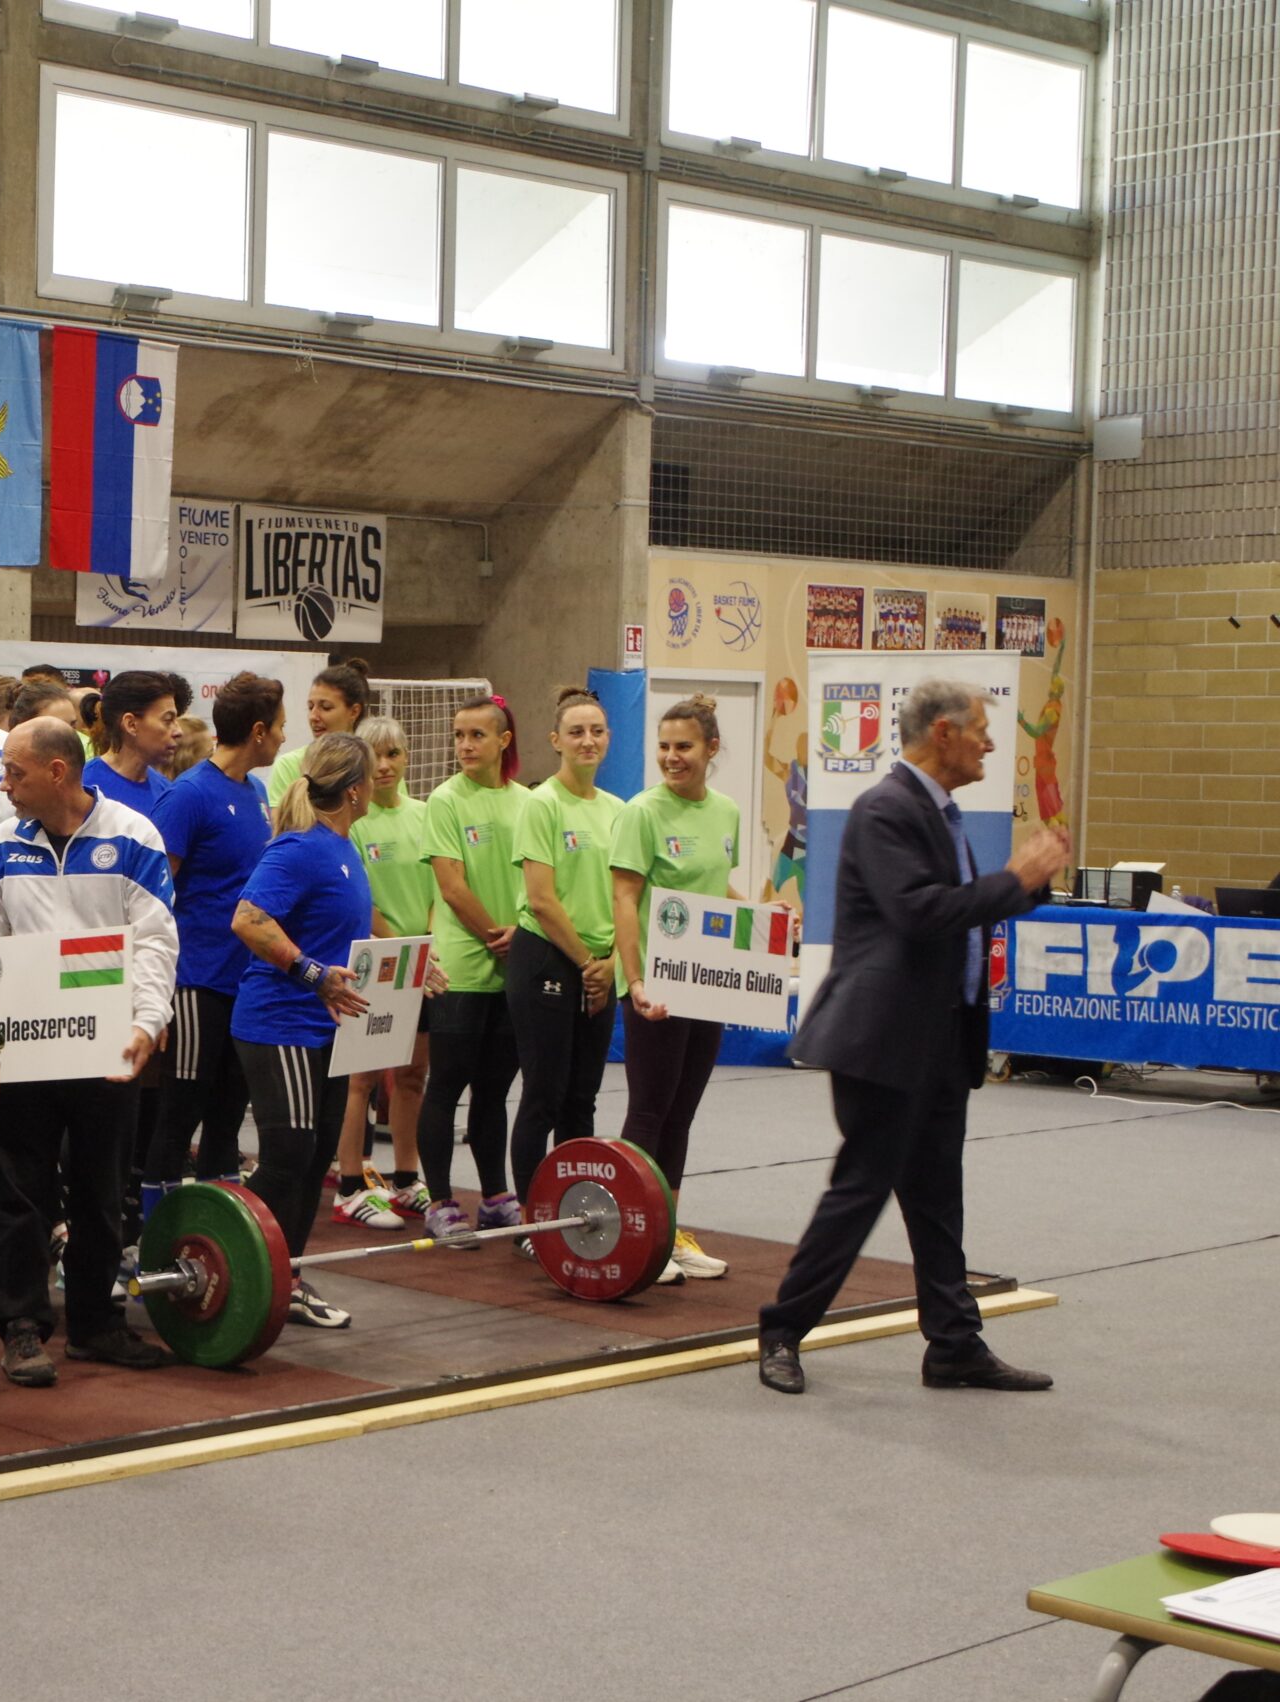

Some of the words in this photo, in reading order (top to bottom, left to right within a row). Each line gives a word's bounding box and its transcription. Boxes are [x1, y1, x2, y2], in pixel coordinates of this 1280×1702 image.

[179, 507, 230, 528] FIUME
[179, 531, 229, 546] VENETO
[245, 519, 381, 604] LIBERTAS
[826, 686, 878, 698] ITALIA
[827, 760, 873, 771] FIPE
[6, 853, 44, 864] Zeus
[1015, 920, 1280, 1005] FIPE
[653, 957, 687, 983] Friuli
[692, 962, 741, 990] Venezia
[746, 970, 783, 995] Giulia
[1015, 994, 1121, 1021] FEDERAZIONE
[1126, 1000, 1200, 1025] ITALIANA
[1206, 1004, 1280, 1031] PESISTIC
[366, 1012, 394, 1036] Veneto
[557, 1161, 616, 1181] ELEIKO
